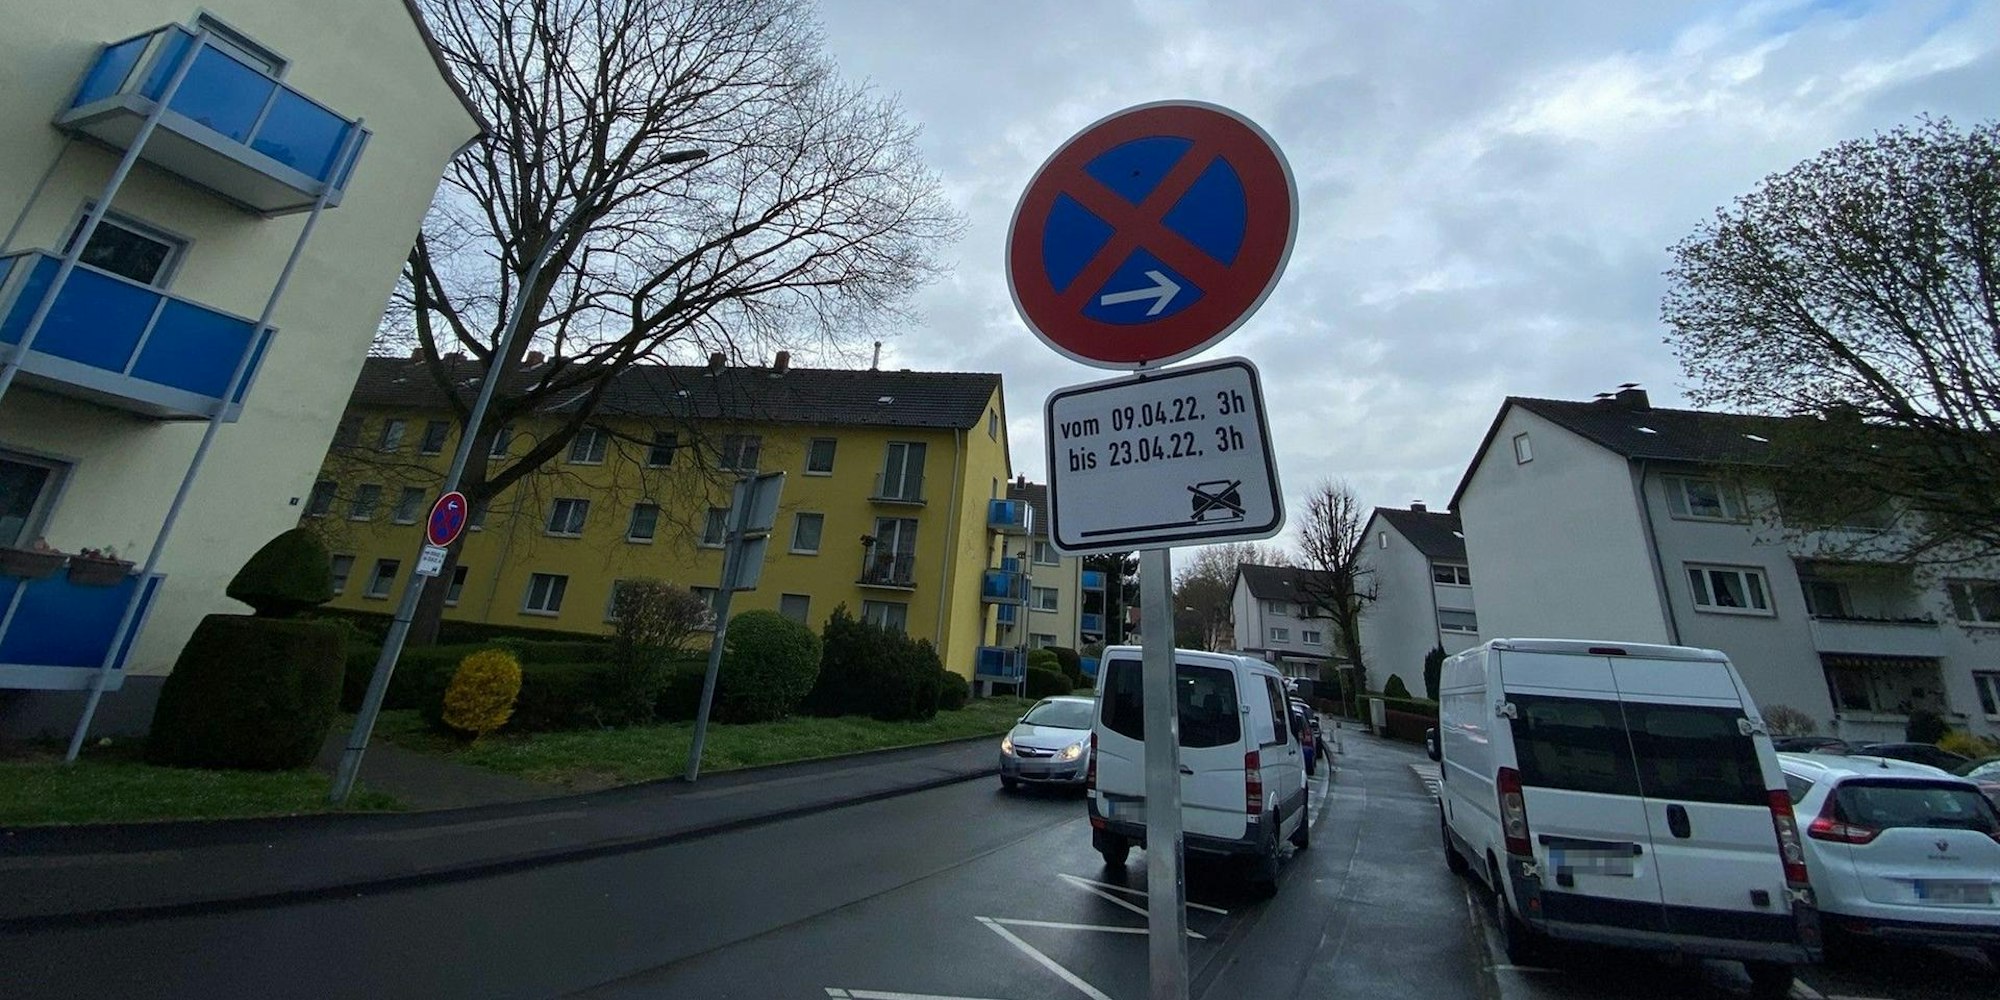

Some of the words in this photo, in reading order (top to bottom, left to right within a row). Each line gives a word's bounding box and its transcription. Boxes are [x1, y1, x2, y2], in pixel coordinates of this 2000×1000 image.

[1061, 418, 1099, 439] vom
[1112, 396, 1205, 431] 09.04.22,
[1217, 389, 1245, 415] 3h
[1069, 448, 1097, 472] bis
[1109, 431, 1203, 466] 23.04.22,
[1215, 425, 1244, 452] 3h
